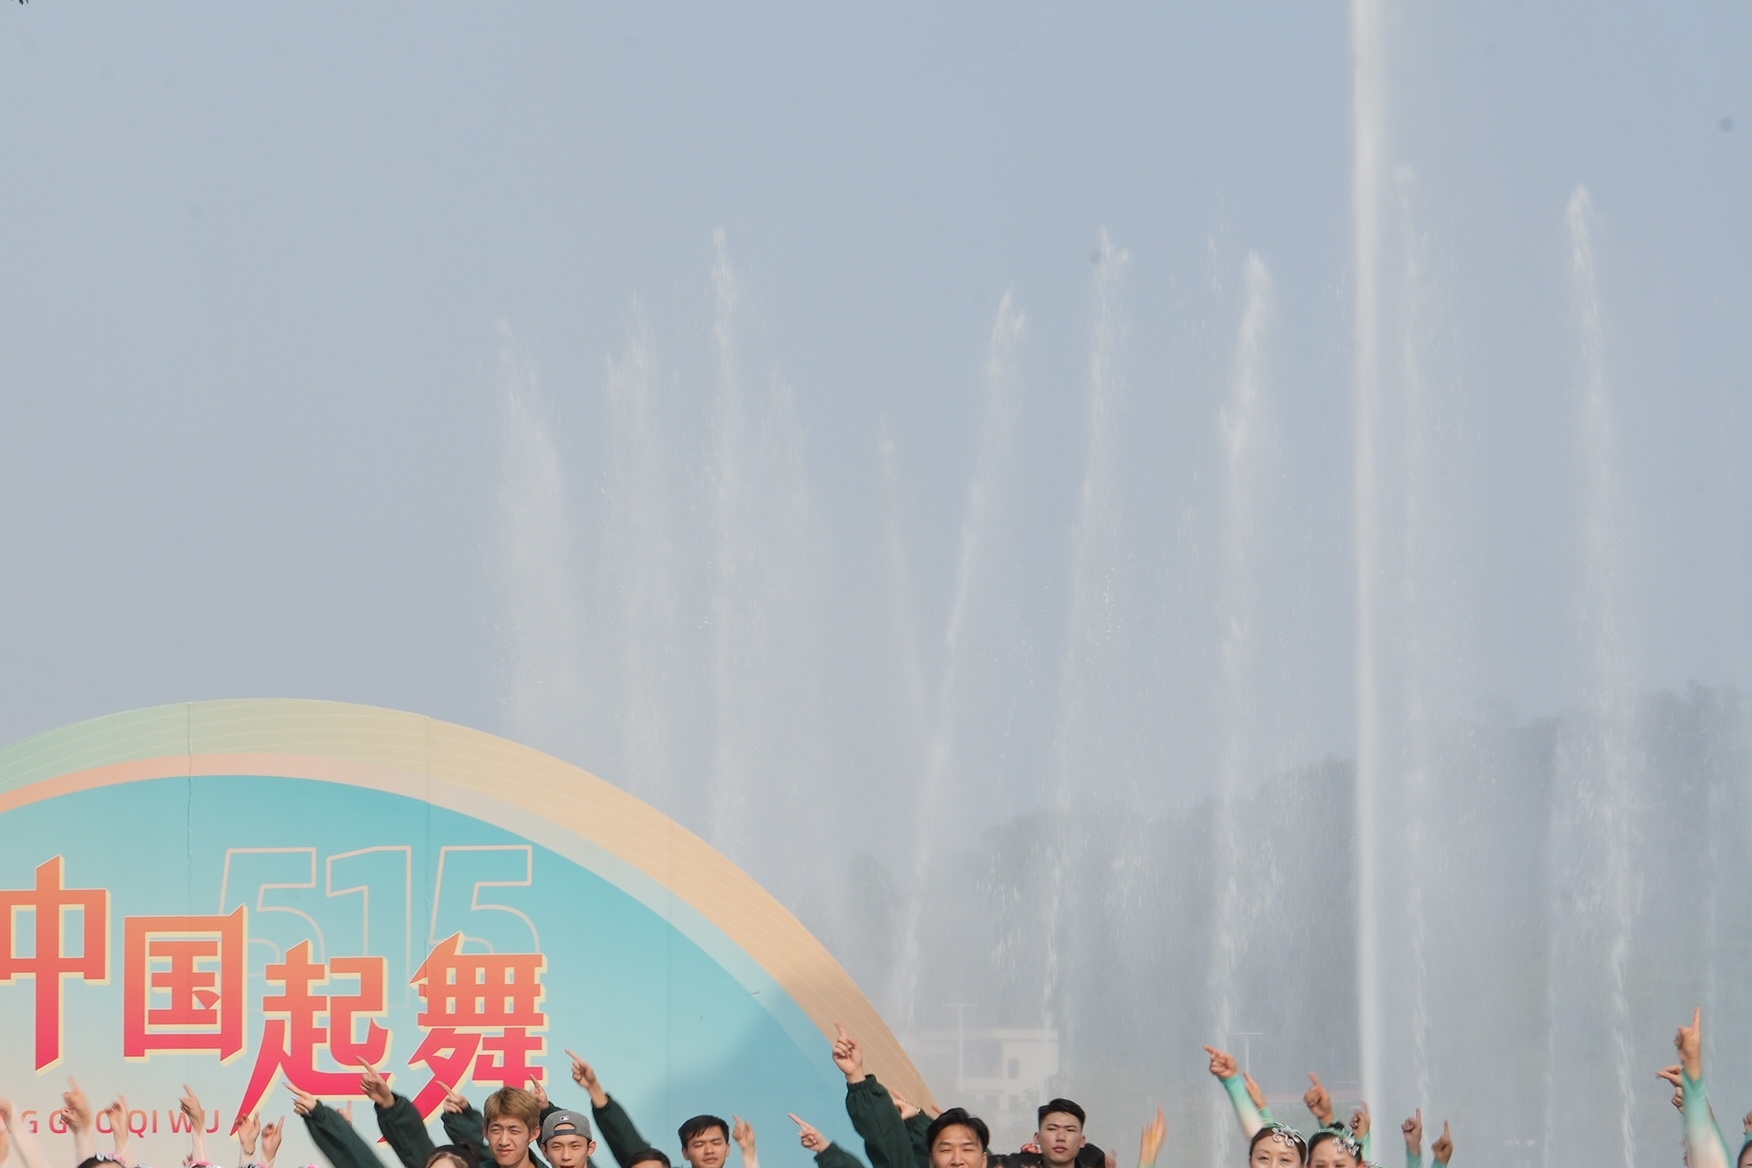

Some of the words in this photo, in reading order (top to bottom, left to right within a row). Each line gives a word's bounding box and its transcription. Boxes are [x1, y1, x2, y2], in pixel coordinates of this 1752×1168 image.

[215, 845, 542, 1012] 515
[49, 1109, 116, 1134] GO
[128, 1109, 158, 1139] QI
